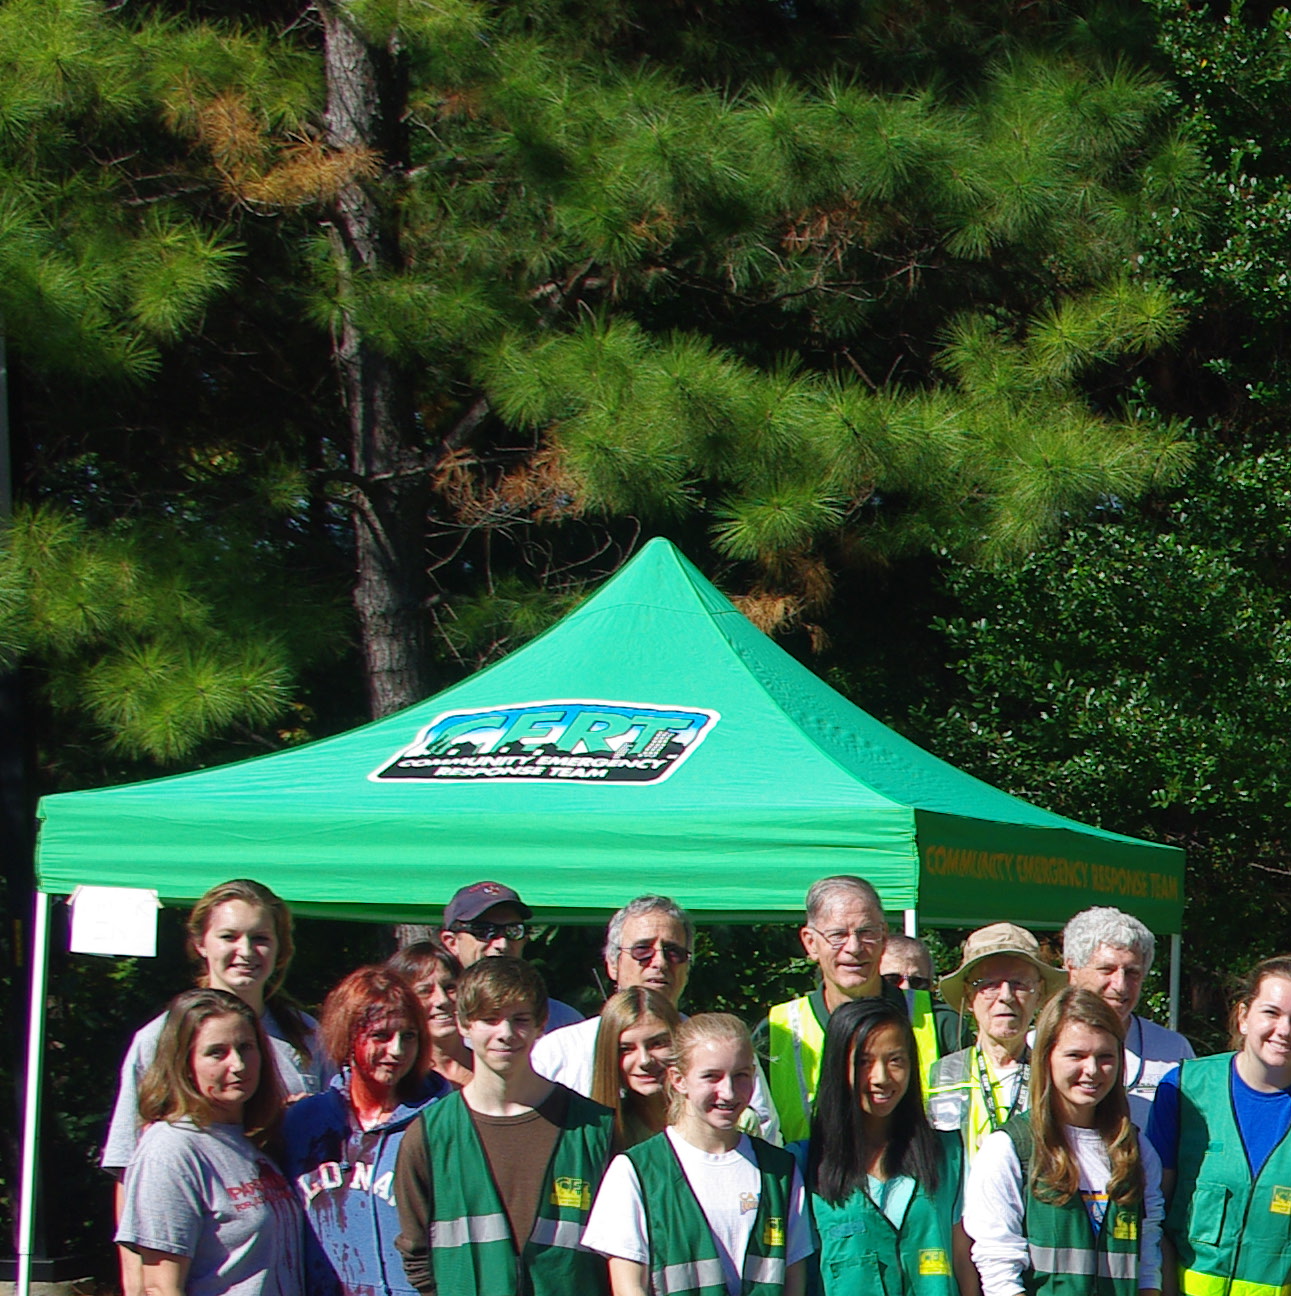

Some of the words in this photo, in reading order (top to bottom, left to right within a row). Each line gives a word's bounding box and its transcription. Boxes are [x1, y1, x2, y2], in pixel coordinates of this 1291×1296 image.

[426, 710, 694, 752] CERT
[398, 755, 530, 768] COMMUNITY
[534, 756, 668, 770] EMERGENCY
[434, 766, 544, 778] RESPONSE
[548, 768, 609, 779] TEAM
[926, 846, 1014, 881] COMMUNITY
[1016, 854, 1088, 888] EMERGENCY
[1091, 864, 1147, 897] RESPONSE
[1149, 873, 1179, 900] TEAM
